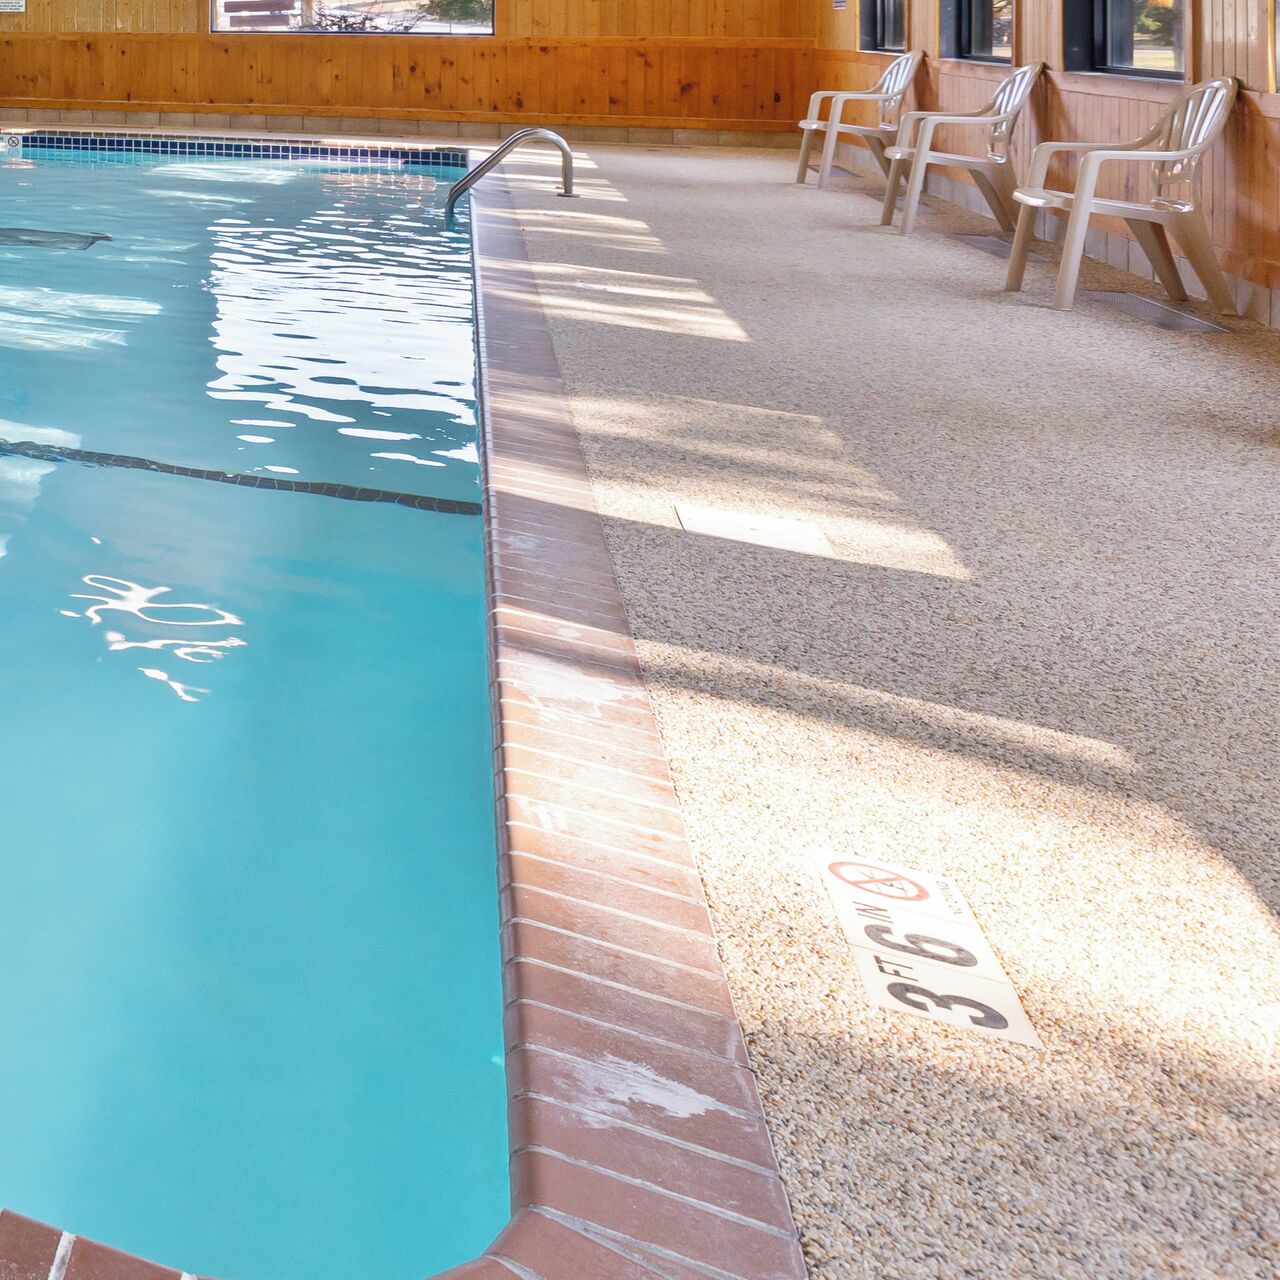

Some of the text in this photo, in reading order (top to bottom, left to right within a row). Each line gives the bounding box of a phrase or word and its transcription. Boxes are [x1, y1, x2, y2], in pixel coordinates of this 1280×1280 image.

[851, 900, 1009, 1030] 3 FT 6 IN
